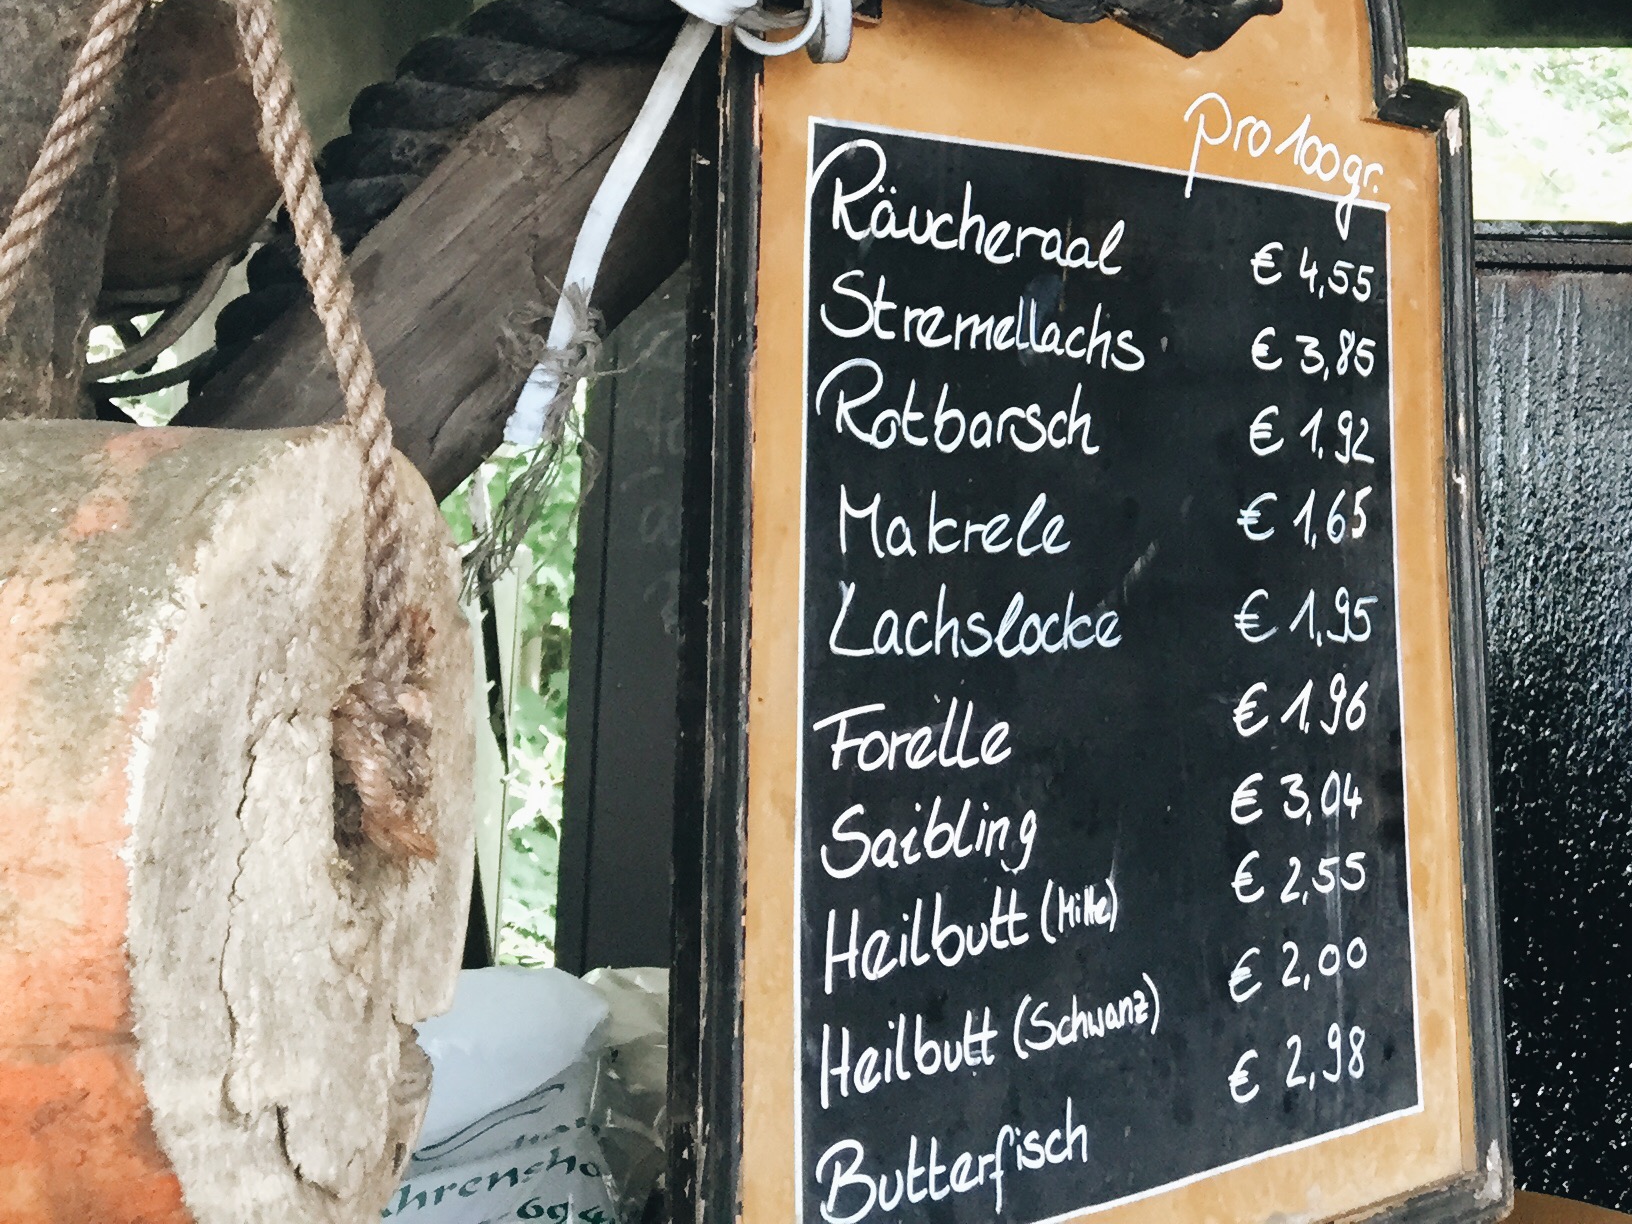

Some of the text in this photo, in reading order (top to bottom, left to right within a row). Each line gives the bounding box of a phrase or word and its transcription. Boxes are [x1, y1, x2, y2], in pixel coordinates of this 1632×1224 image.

[1184, 93, 1270, 197] pro
[810, 139, 1375, 303] Räucheraal € 4,55
[820, 269, 1377, 382] Stremellachs € 3,85
[815, 357, 1375, 465] Rotbarsch € 1,92
[839, 483, 1373, 559] Makrele € 1,65
[828, 580, 1379, 659] Lachslocke € 1,95
[812, 672, 1369, 772] Forelle € 1,96
[820, 769, 1363, 879] Saibling € 3,04
[824, 849, 1366, 995] Heilbutt (Mitte) € 2,55
[820, 936, 1368, 1110] Heilbutt (Schwanz) € 2,00
[815, 1022, 1366, 1223] Butterfisch € 2,98
